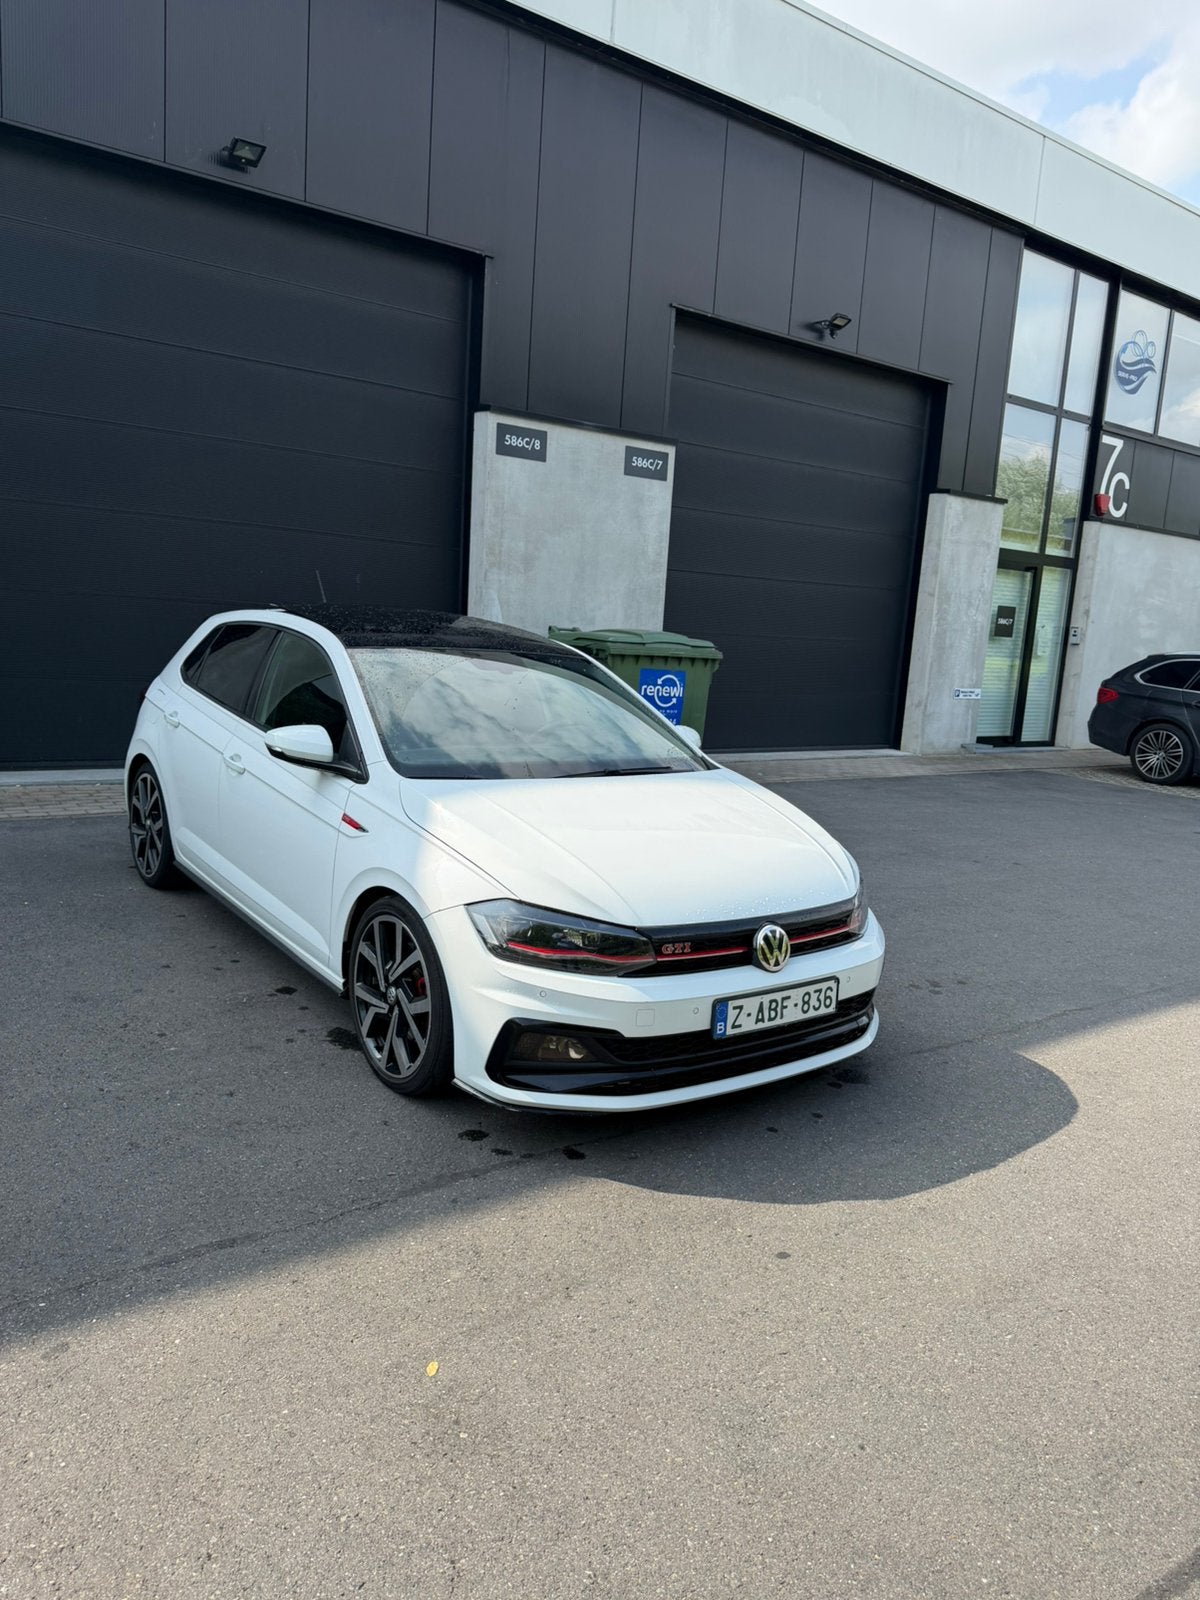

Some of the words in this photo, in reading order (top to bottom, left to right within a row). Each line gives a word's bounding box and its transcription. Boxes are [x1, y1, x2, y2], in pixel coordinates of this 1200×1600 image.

[504, 434, 541, 450] 586C/8
[631, 456, 663, 471] 586C/7
[641, 683, 684, 697] renewi
[661, 942, 692, 954] GTI
[731, 986, 833, 1029] Z-ABF-836
[716, 1022, 725, 1034] B
